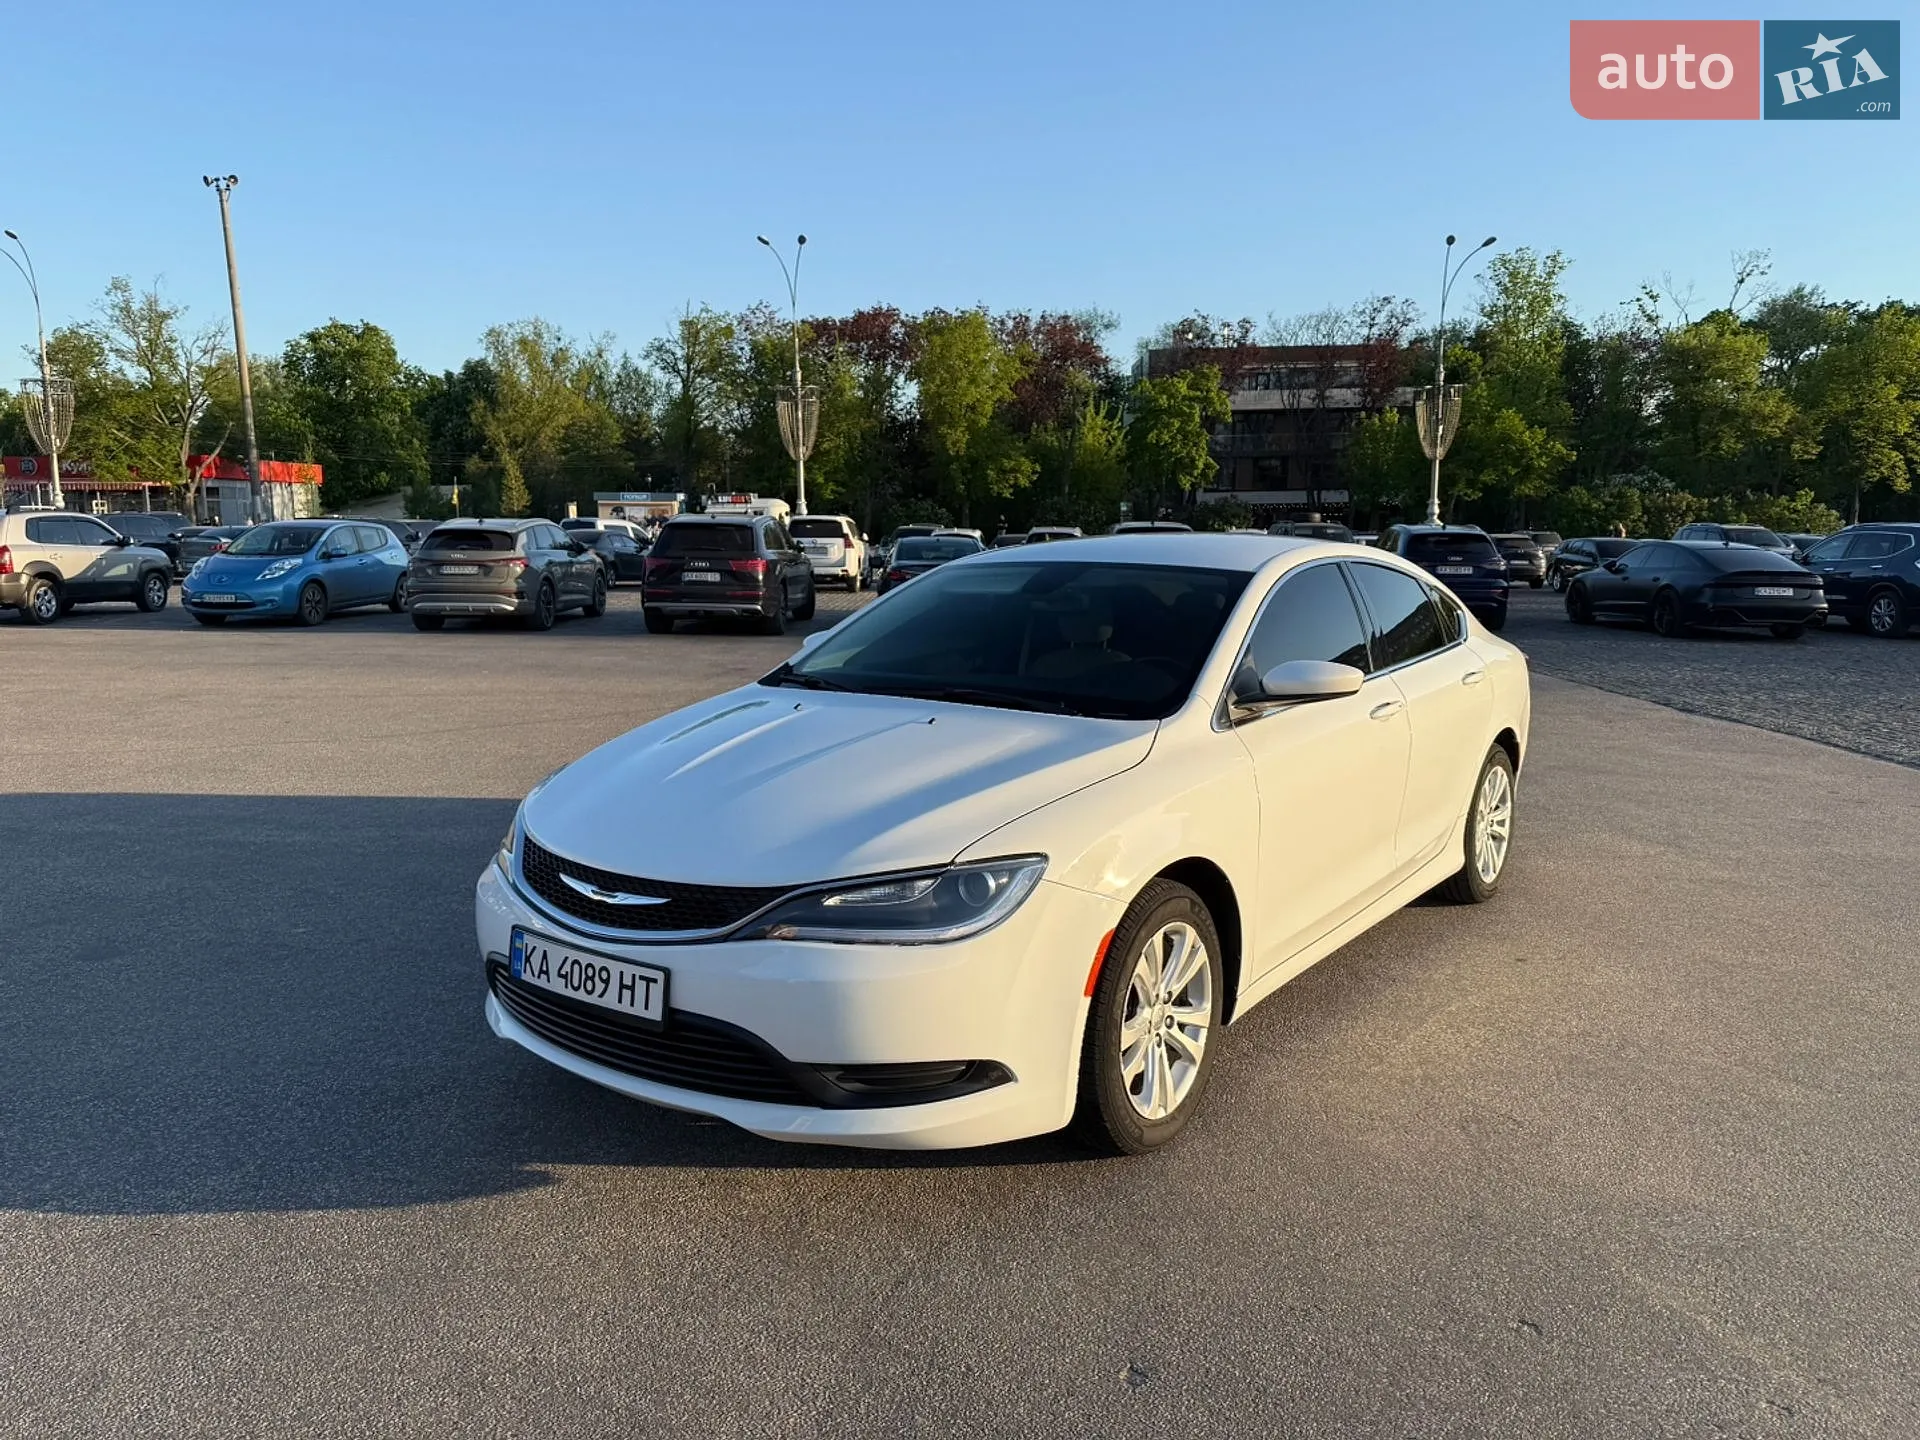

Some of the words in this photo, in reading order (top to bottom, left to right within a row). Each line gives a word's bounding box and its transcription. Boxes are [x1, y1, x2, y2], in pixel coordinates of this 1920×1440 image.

[523, 942, 551, 983] KA
[557, 956, 611, 999] 4089
[617, 970, 658, 1011] HT
